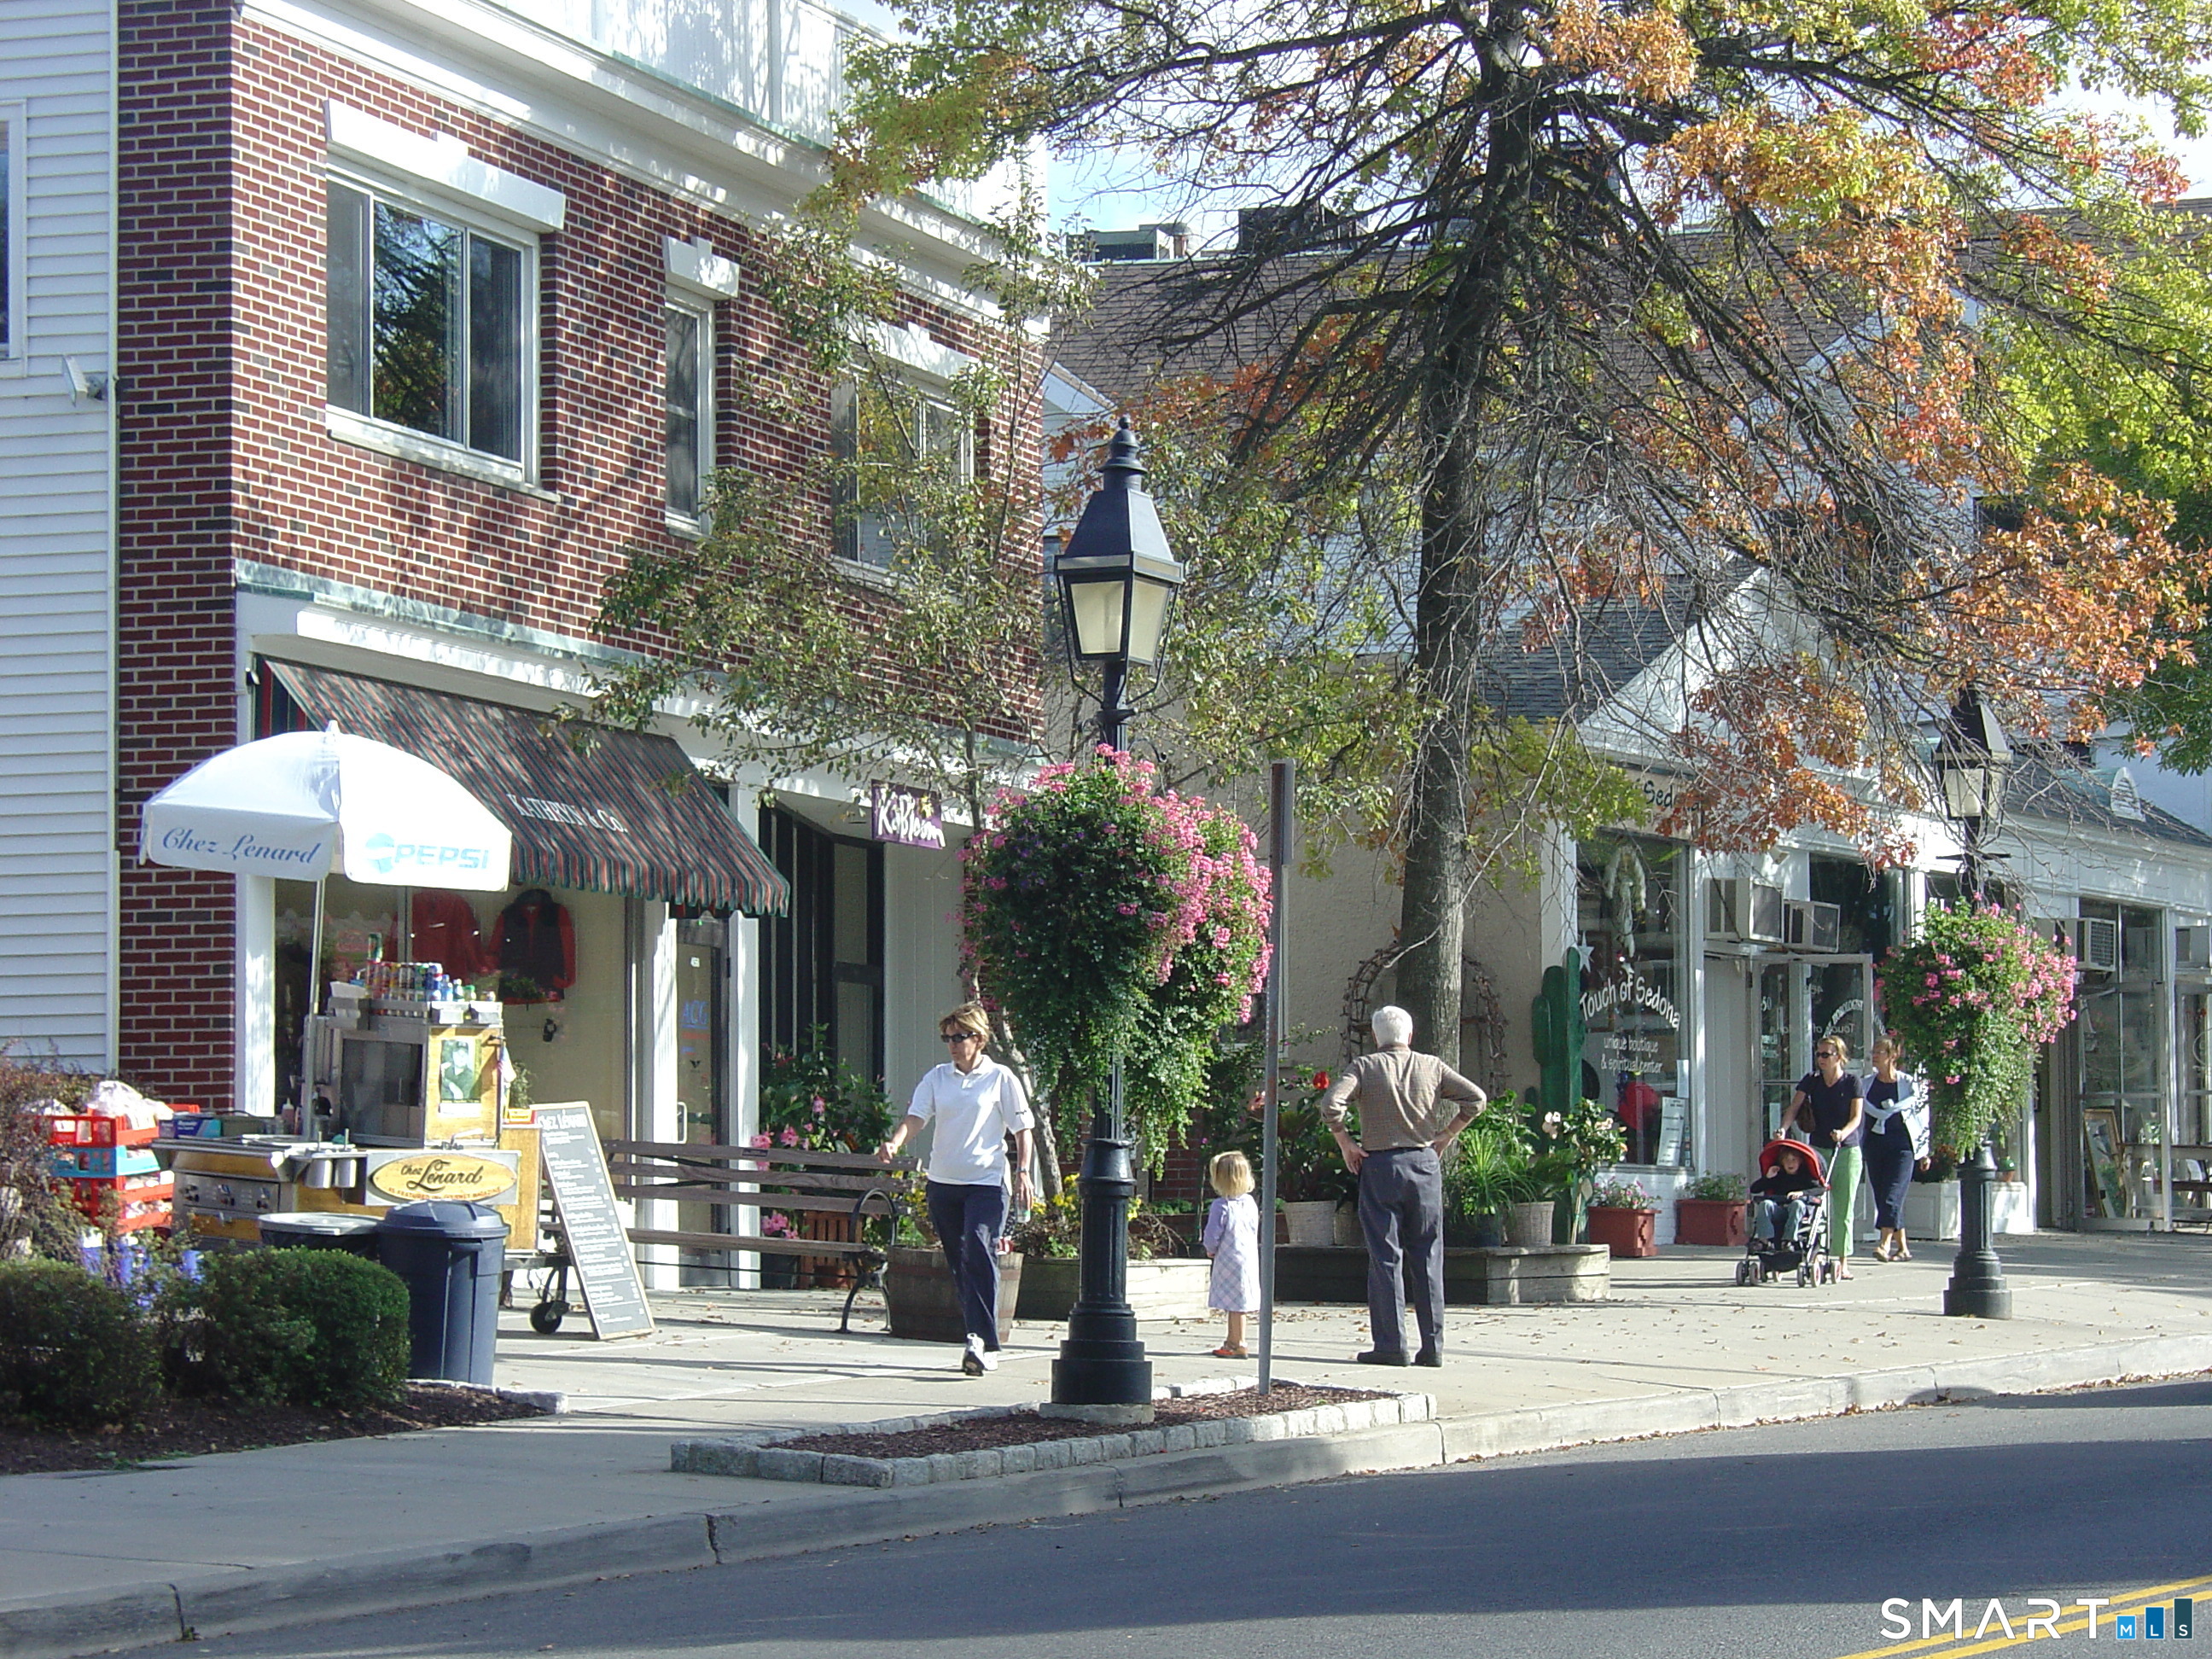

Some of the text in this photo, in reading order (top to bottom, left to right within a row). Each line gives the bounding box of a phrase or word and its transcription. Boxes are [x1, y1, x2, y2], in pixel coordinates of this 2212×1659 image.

[1644, 780, 1700, 812] Seda
[506, 794, 629, 833] KATHRYN & Co.
[162, 827, 322, 864] Chez Lenard
[394, 844, 489, 869] PEPSI
[1579, 974, 1680, 1031] Touch of Sedona
[1604, 1034, 1658, 1058] unique boutique
[1601, 1053, 1663, 1076] & spiritual center
[401, 1159, 484, 1192] Chez Lenard
